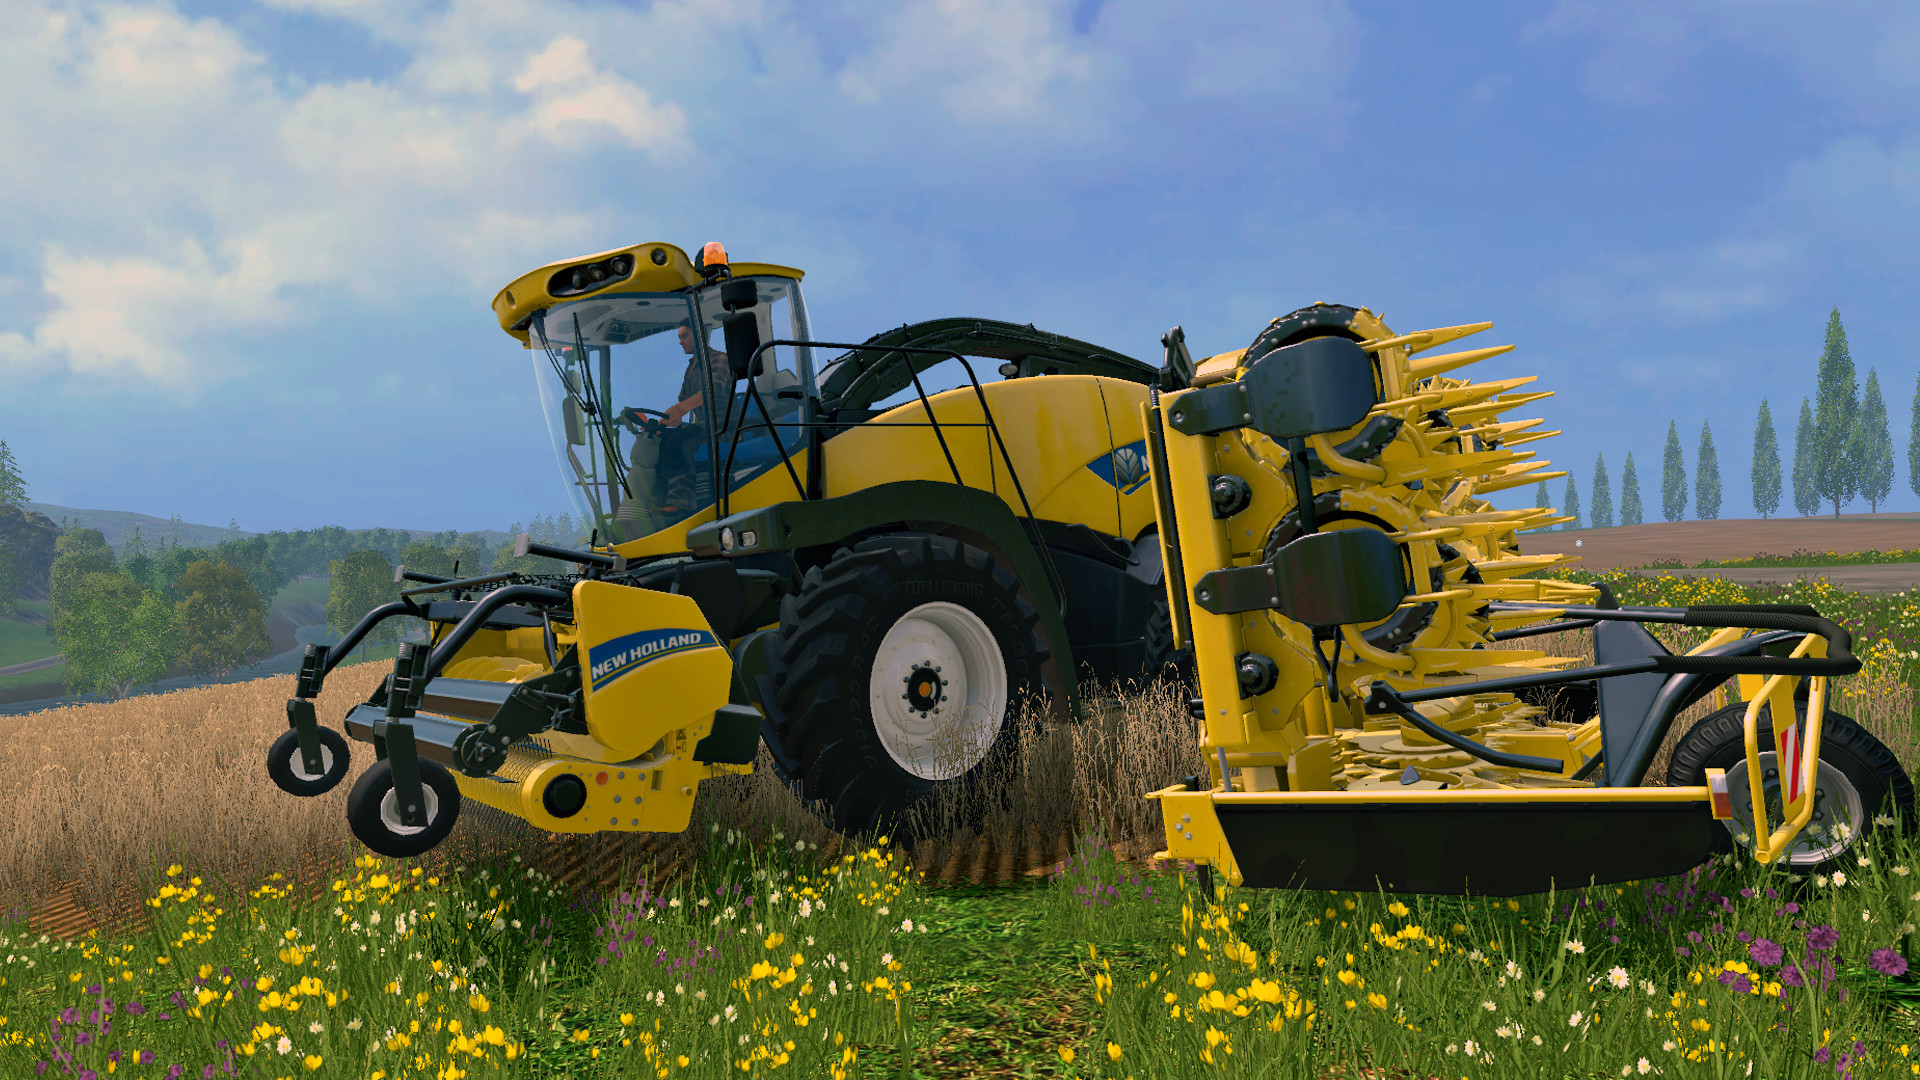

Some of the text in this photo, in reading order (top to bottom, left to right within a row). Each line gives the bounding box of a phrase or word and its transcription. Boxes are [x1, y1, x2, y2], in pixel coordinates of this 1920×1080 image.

[902, 580, 984, 598] TRELLEBORG
[592, 633, 702, 680] NEW HOLLAND
